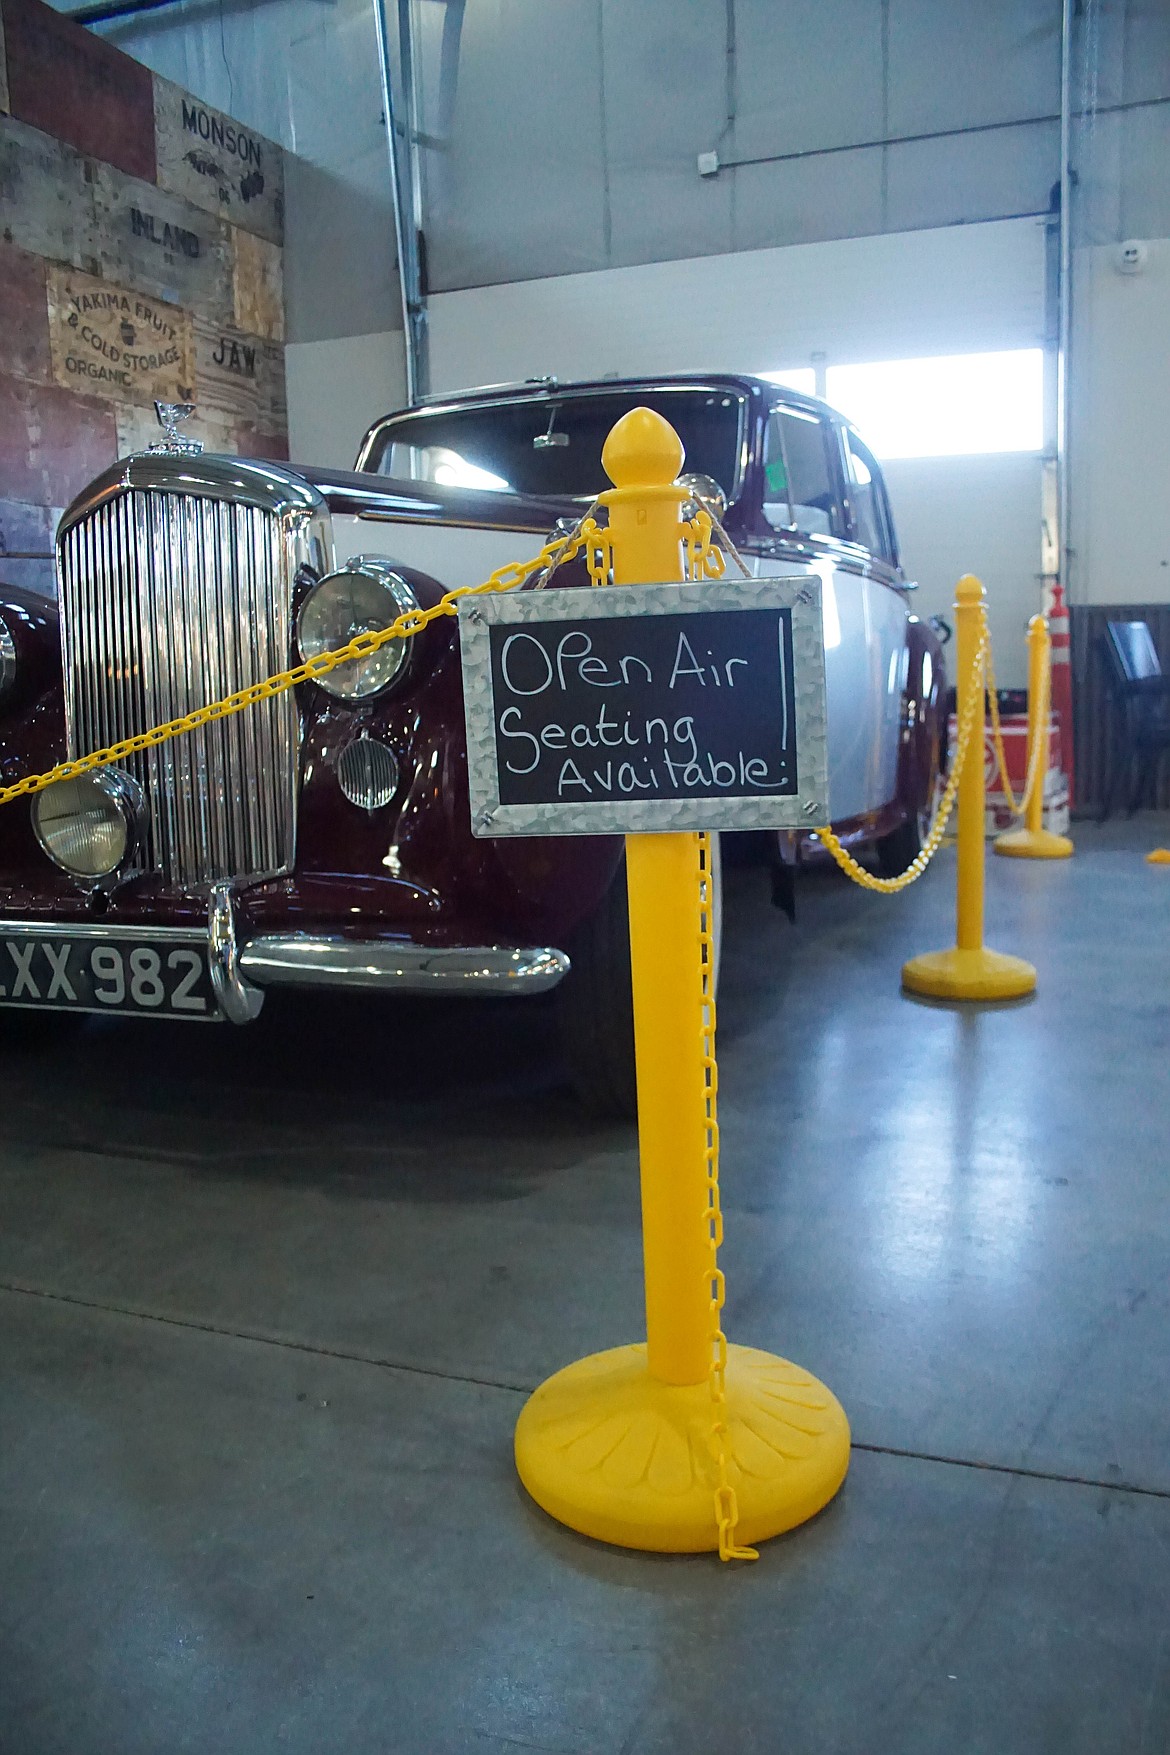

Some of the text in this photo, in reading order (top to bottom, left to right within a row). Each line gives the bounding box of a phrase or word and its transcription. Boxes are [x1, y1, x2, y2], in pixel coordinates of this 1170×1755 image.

[181, 99, 261, 168] MONSON
[130, 207, 200, 258] INLAND
[70, 293, 178, 341] YAKIMA FRUIT
[65, 356, 132, 387] ORGANIC
[81, 325, 120, 362] COLD
[123, 345, 181, 371] STORAGE
[669, 631, 749, 689] Air
[499, 703, 699, 775] Seating
[0, 942, 207, 1011] XX 982
